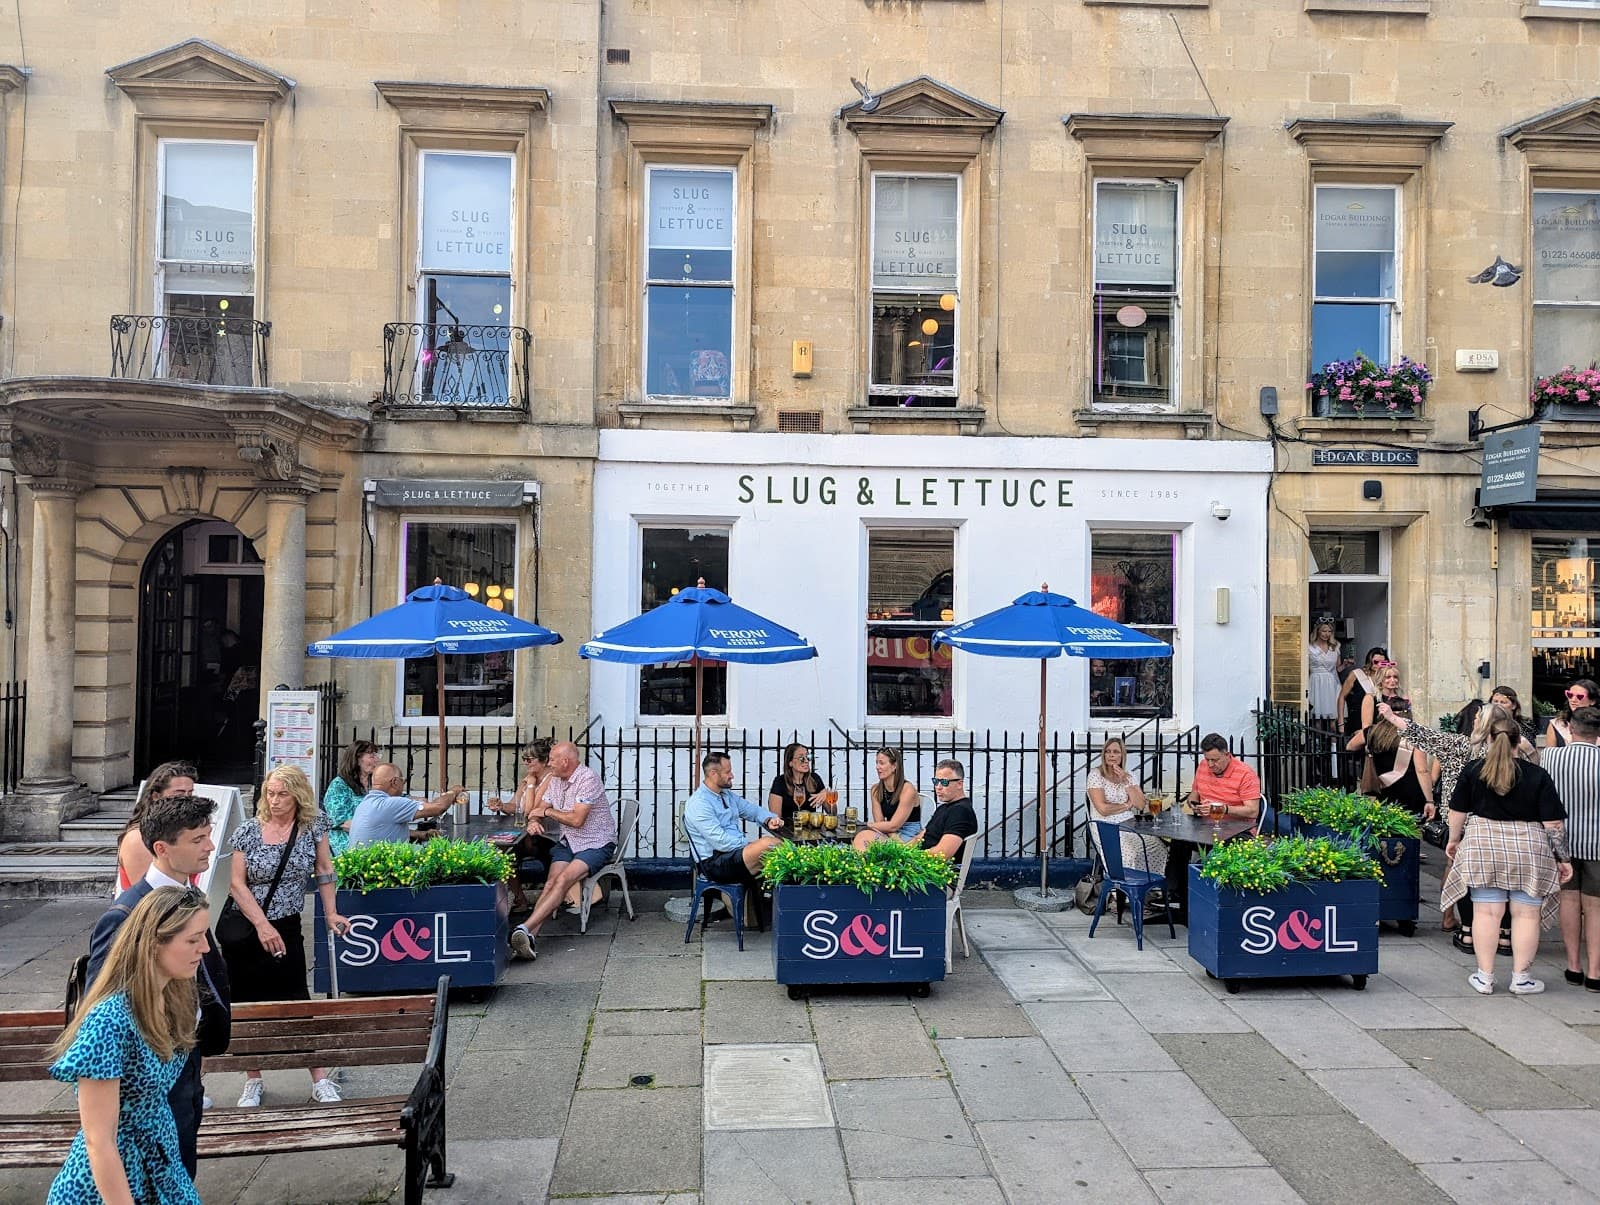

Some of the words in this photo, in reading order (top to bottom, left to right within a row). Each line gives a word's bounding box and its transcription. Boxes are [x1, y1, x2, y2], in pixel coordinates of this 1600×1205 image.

[673, 187, 710, 199] SLUG
[687, 203, 695, 214] &
[452, 210, 489, 223] SLUG
[659, 218, 724, 230] LETTUCE
[1112, 223, 1148, 235] SLUG
[195, 230, 234, 243] SLUG
[465, 226, 475, 238] &
[895, 231, 930, 243] SLUG
[436, 240, 504, 255] LETTUCE
[1125, 238, 1134, 250] &
[209, 246, 219, 258] &
[908, 247, 916, 259] &
[1541, 250, 1568, 259] 01225
[1098, 253, 1161, 265] LETTUCE
[881, 261, 943, 274] LETTUCE
[1476, 353, 1494, 361] DSA
[1320, 451, 1365, 462] EDGAR
[1486, 473, 1504, 484] 01225
[404, 490, 431, 499] SLUG
[434, 490, 440, 499] &
[443, 490, 492, 499] LETTUCE
[647, 482, 710, 493] TOGETHER
[737, 474, 837, 505] SLUG
[856, 477, 875, 506] &
[895, 478, 1074, 508] LETTUCE
[1101, 489, 1140, 499] SINCE
[1149, 490, 1179, 500] 1985
[1334, 544, 1345, 564] 7
[447, 619, 512, 628] PERONI
[709, 629, 771, 639] PERONI
[1065, 626, 1124, 635] PERONI
[802, 910, 924, 960] S&L
[1240, 905, 1358, 955] S&L
[339, 912, 471, 967] S&L
